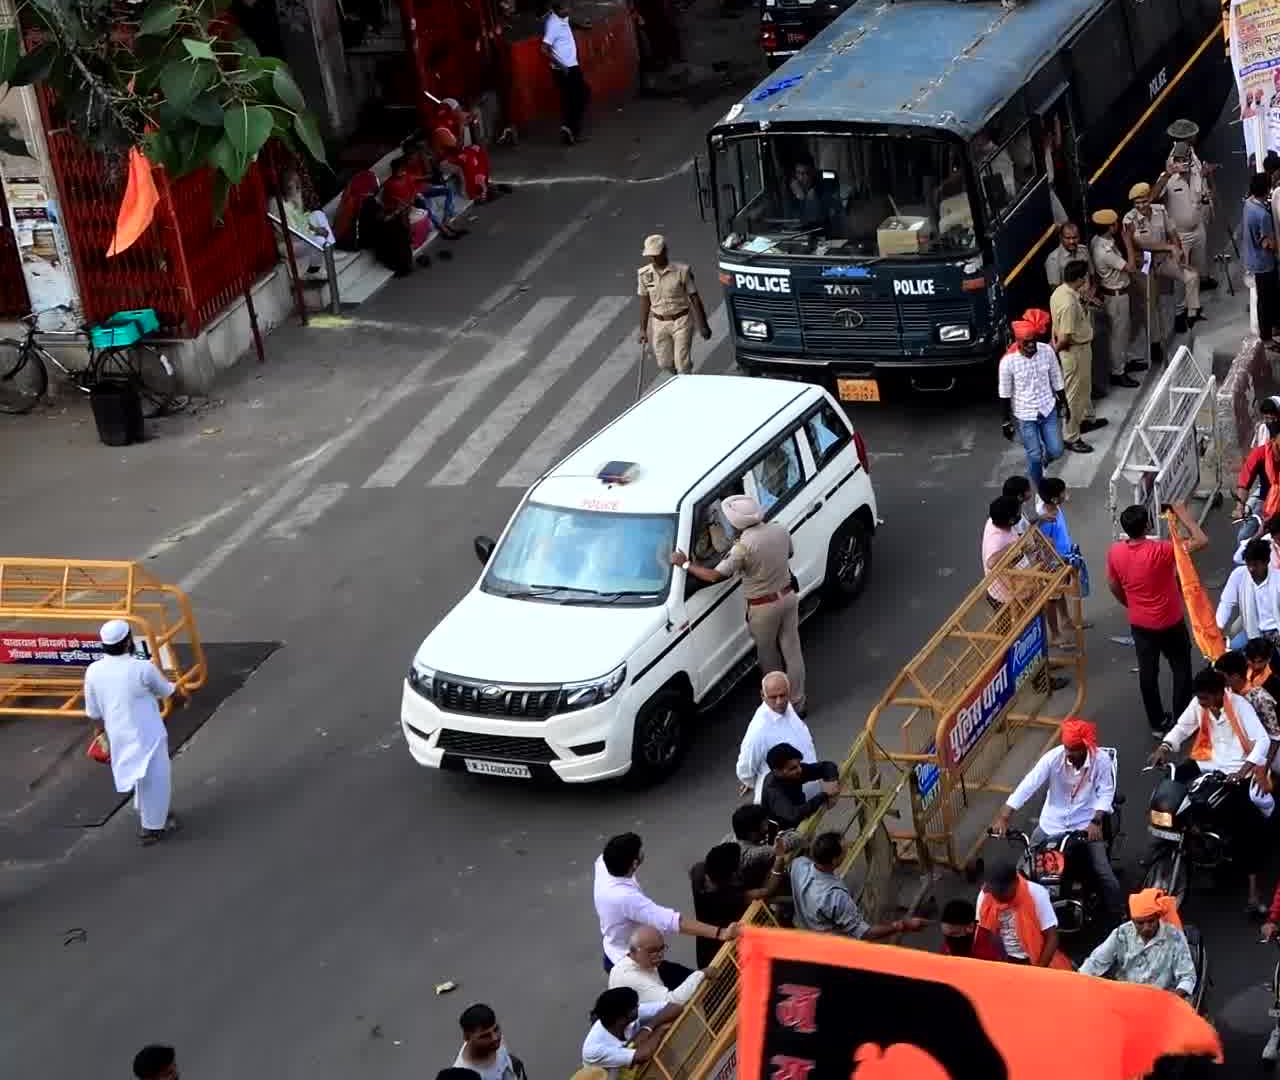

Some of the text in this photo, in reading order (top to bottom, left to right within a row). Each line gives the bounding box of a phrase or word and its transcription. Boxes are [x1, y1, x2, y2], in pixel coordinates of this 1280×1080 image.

[735, 274, 791, 293] POLICE
[824, 284, 861, 295] TATA
[893, 279, 935, 295] POLICE
[69, 637, 81, 648] को
[60, 649, 91, 662] सुरक्षित
[950, 707, 982, 762] पुलिस
[983, 663, 1009, 710] थाना
